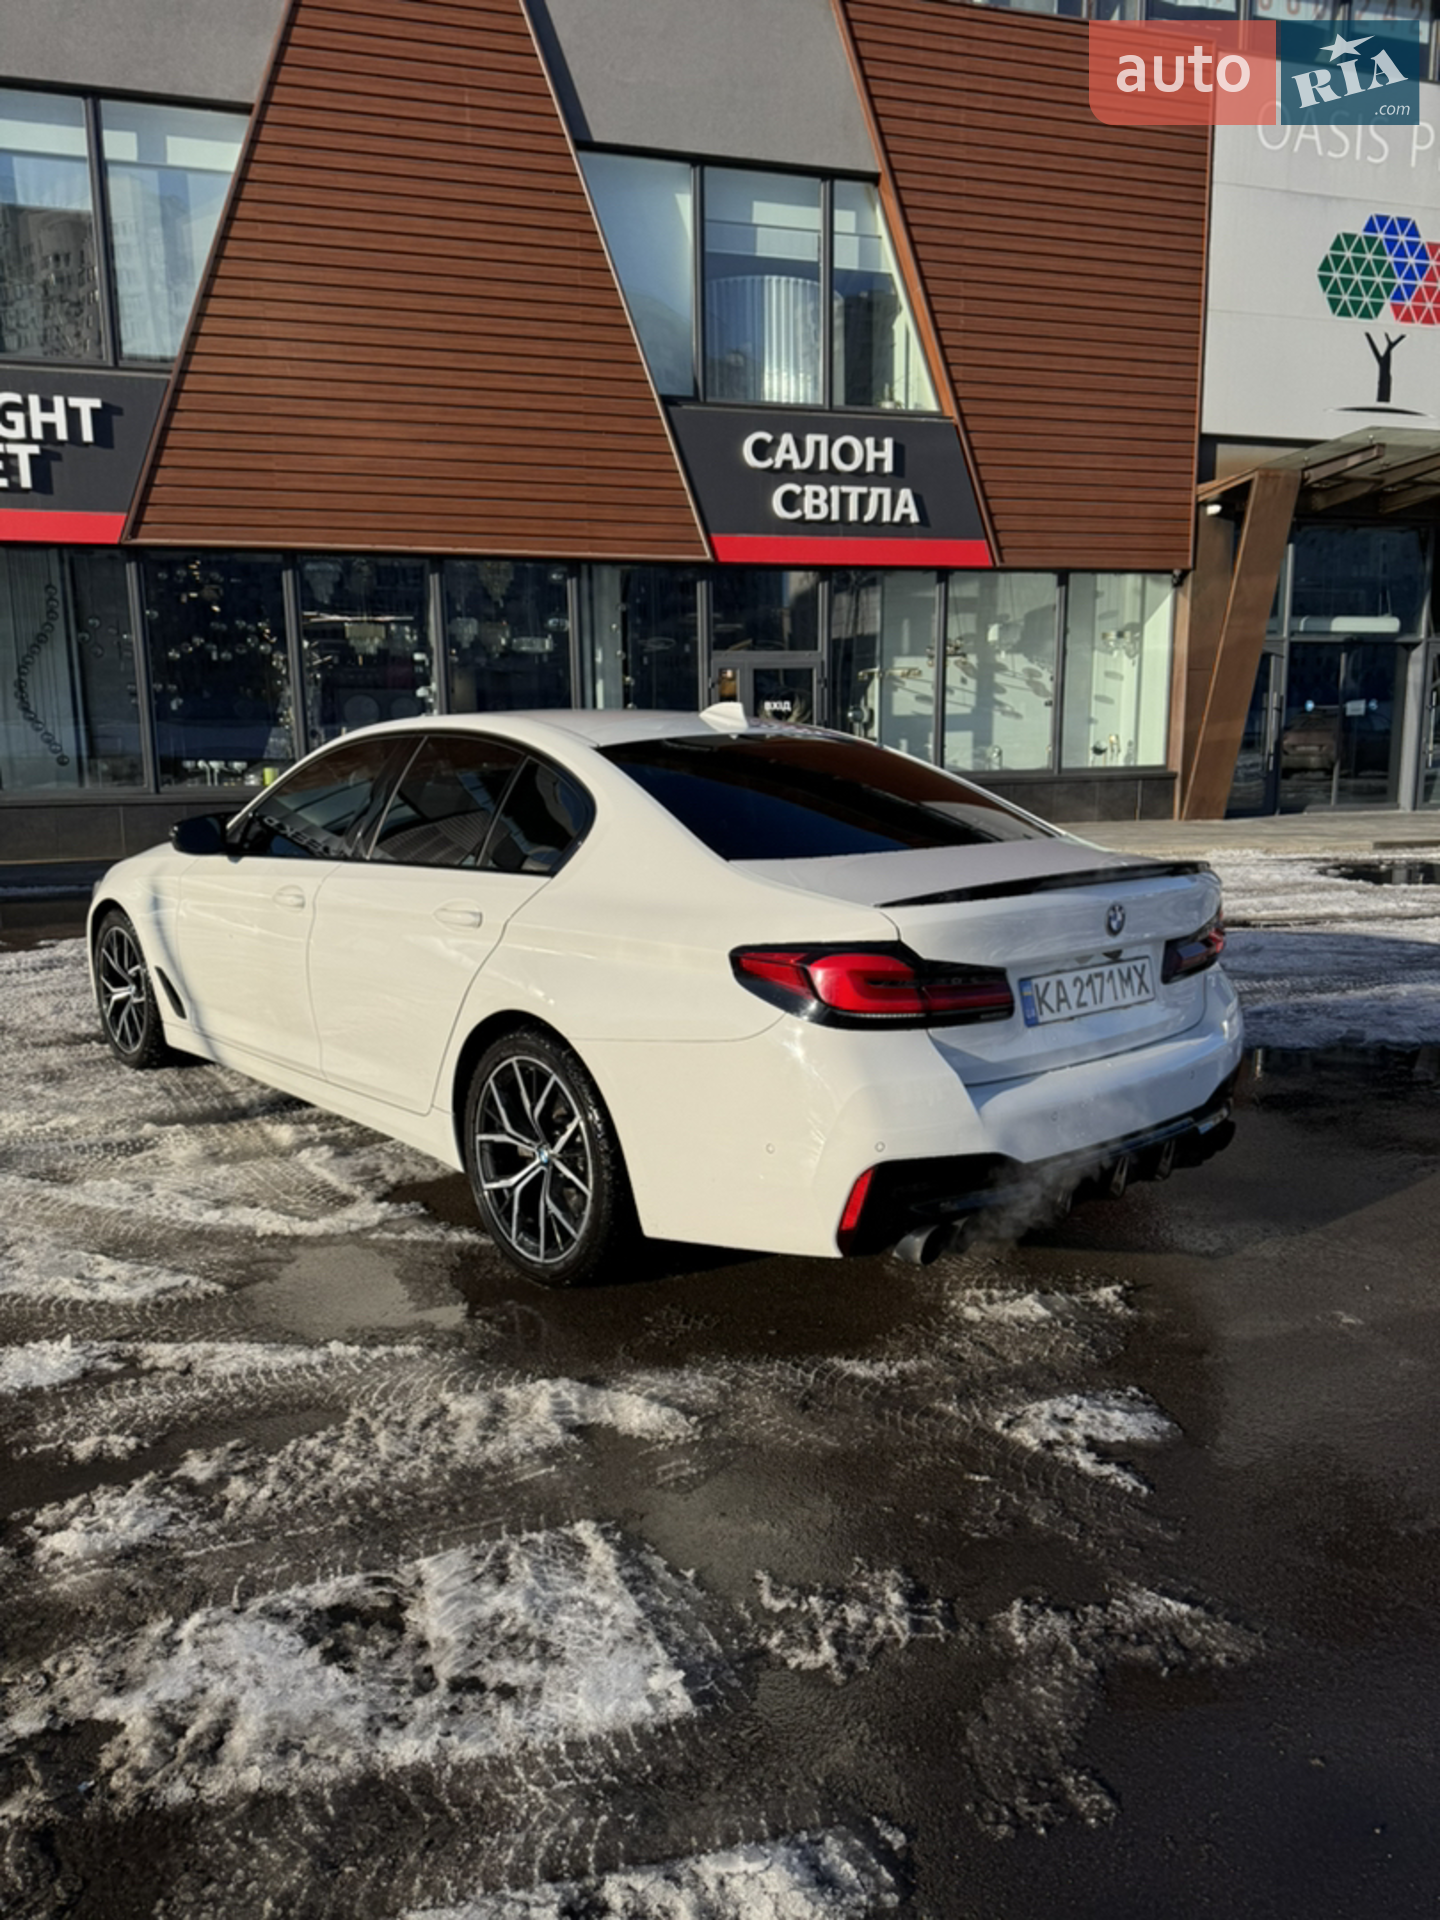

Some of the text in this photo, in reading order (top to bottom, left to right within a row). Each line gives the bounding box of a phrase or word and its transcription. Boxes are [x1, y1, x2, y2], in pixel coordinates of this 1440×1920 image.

[1257, 100, 1440, 168] OASIS P
[0, 392, 102, 443] GHT
[742, 431, 894, 473] САЛОН
[771, 482, 920, 523] СВІТЛА
